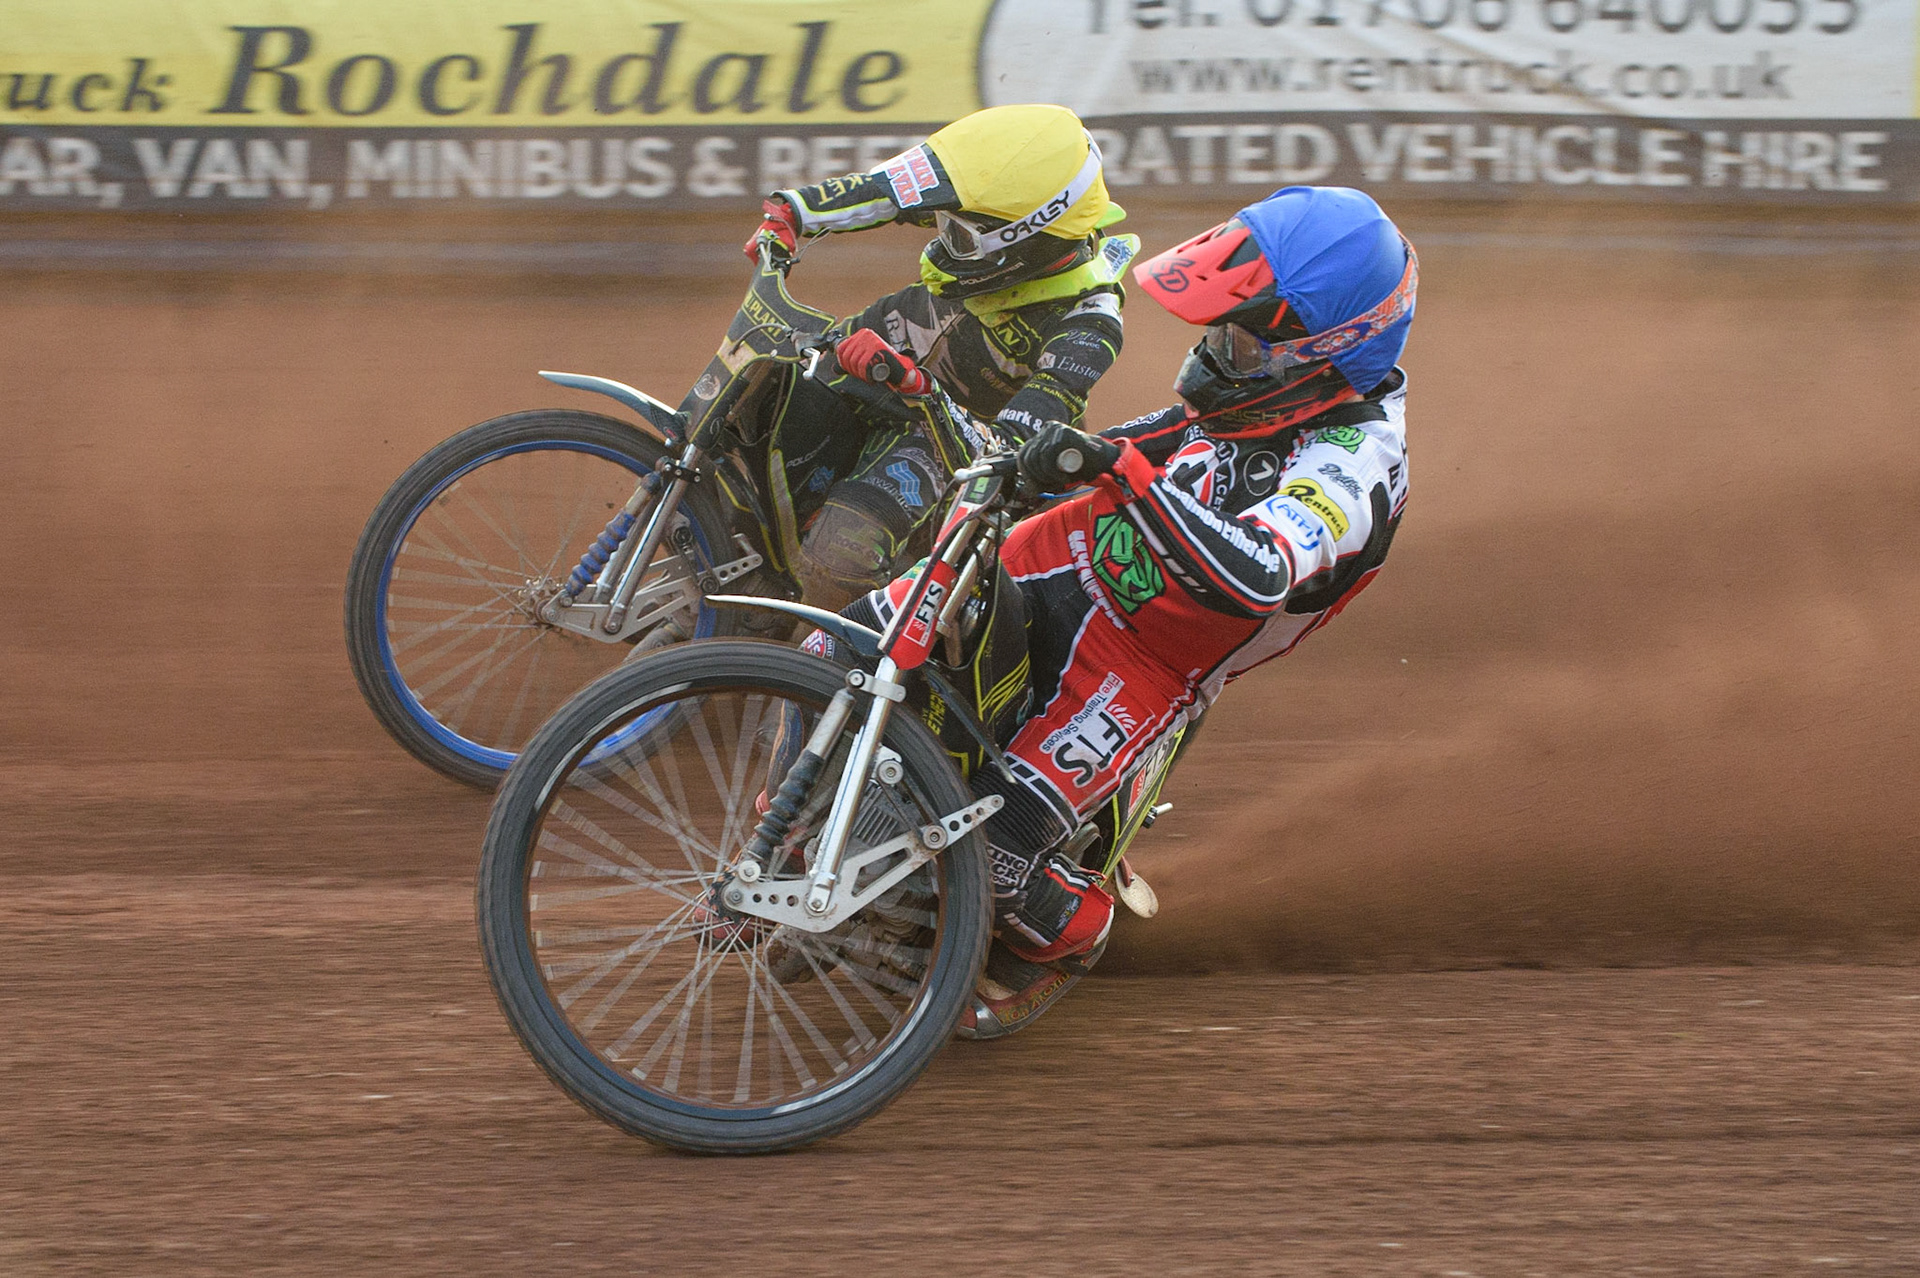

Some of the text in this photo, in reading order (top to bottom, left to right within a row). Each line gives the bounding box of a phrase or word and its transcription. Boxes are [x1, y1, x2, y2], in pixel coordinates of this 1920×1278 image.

[0, 19, 909, 117] uck Rochdale
[1130, 49, 1797, 100] www.rentruck.co.uk
[0, 136, 123, 207] AR,
[133, 136, 333, 209] VAN,
[346, 137, 675, 199] MINIBUS
[690, 136, 752, 198] &
[1348, 122, 1691, 187] VEHICLE
[1704, 130, 1888, 192] HIRE
[818, 174, 872, 206] KET
[1000, 190, 1070, 243] OAKLEY
[997, 407, 1043, 433] Mark &
[1284, 484, 1346, 536] Rentruck
[914, 583, 944, 624] FTS
[1101, 673, 1121, 694] Fire
[1073, 693, 1108, 725] Training
[1054, 711, 1127, 786] FTS
[990, 847, 1027, 872] ING
